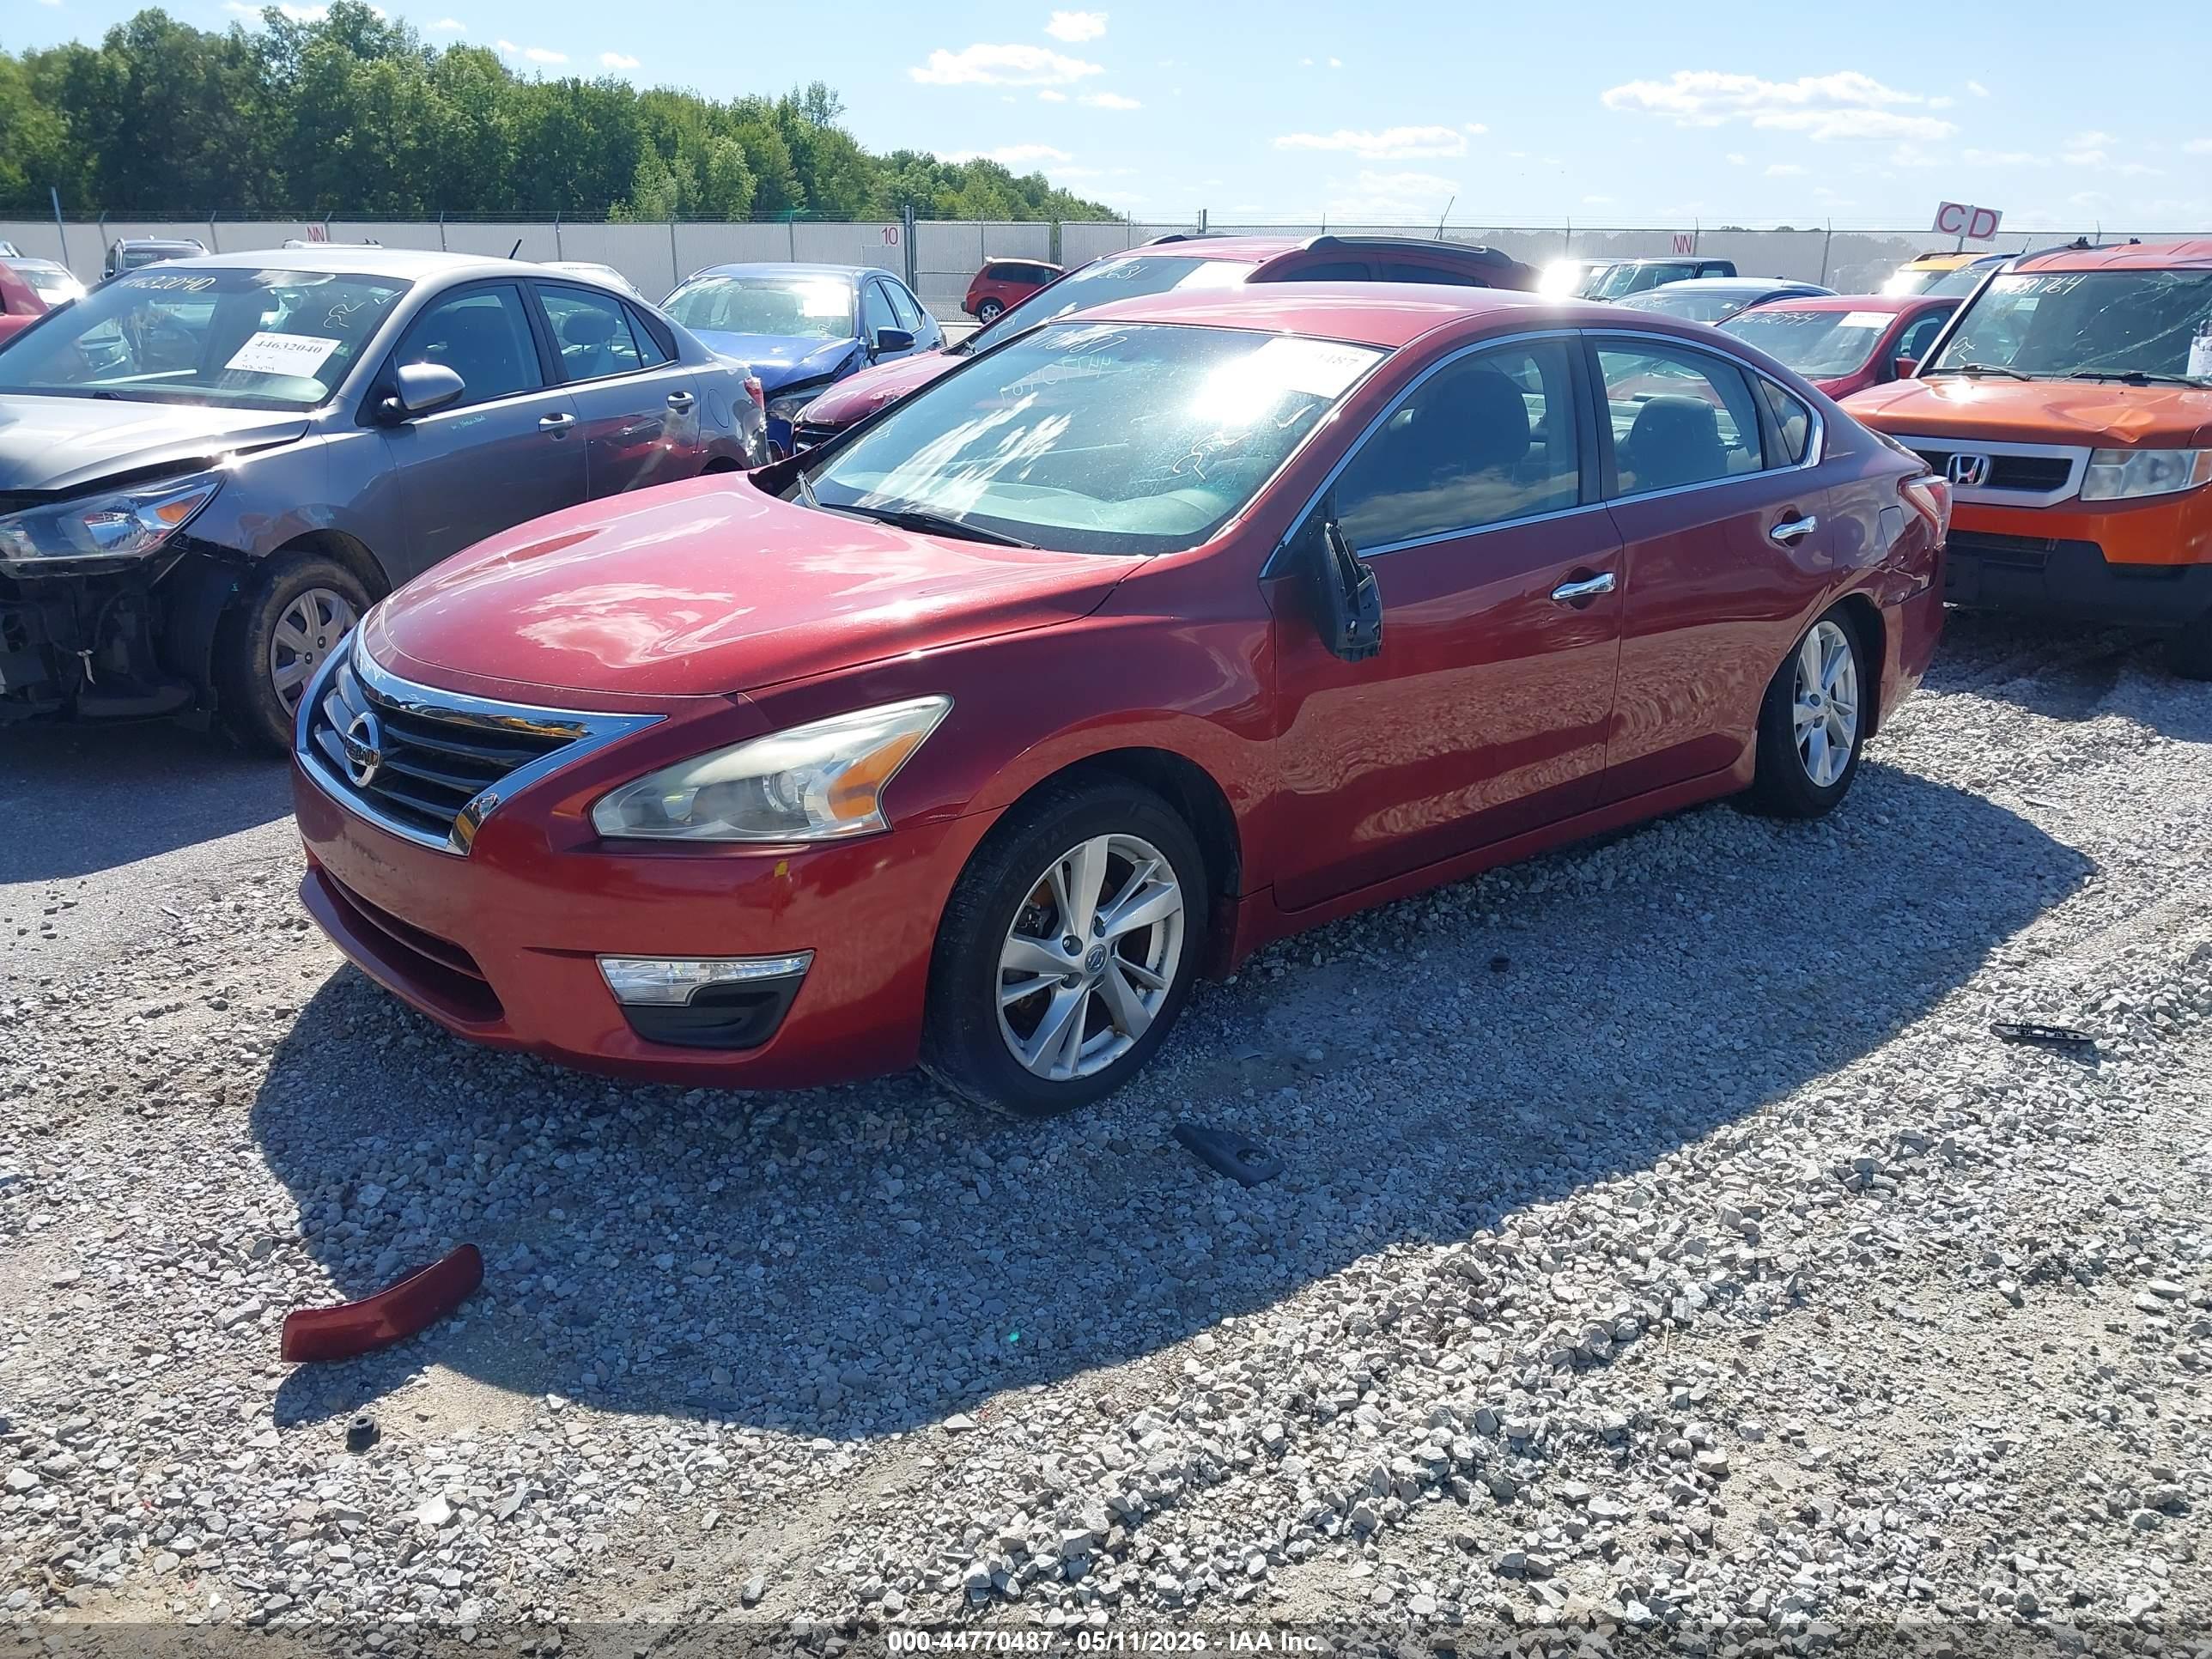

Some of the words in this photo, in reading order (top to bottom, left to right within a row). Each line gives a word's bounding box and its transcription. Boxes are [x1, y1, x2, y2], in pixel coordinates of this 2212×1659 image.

[307, 226, 325, 241] NN
[881, 226, 899, 245] 10
[1673, 234, 1692, 255] NN
[255, 340, 323, 354] 44632040
